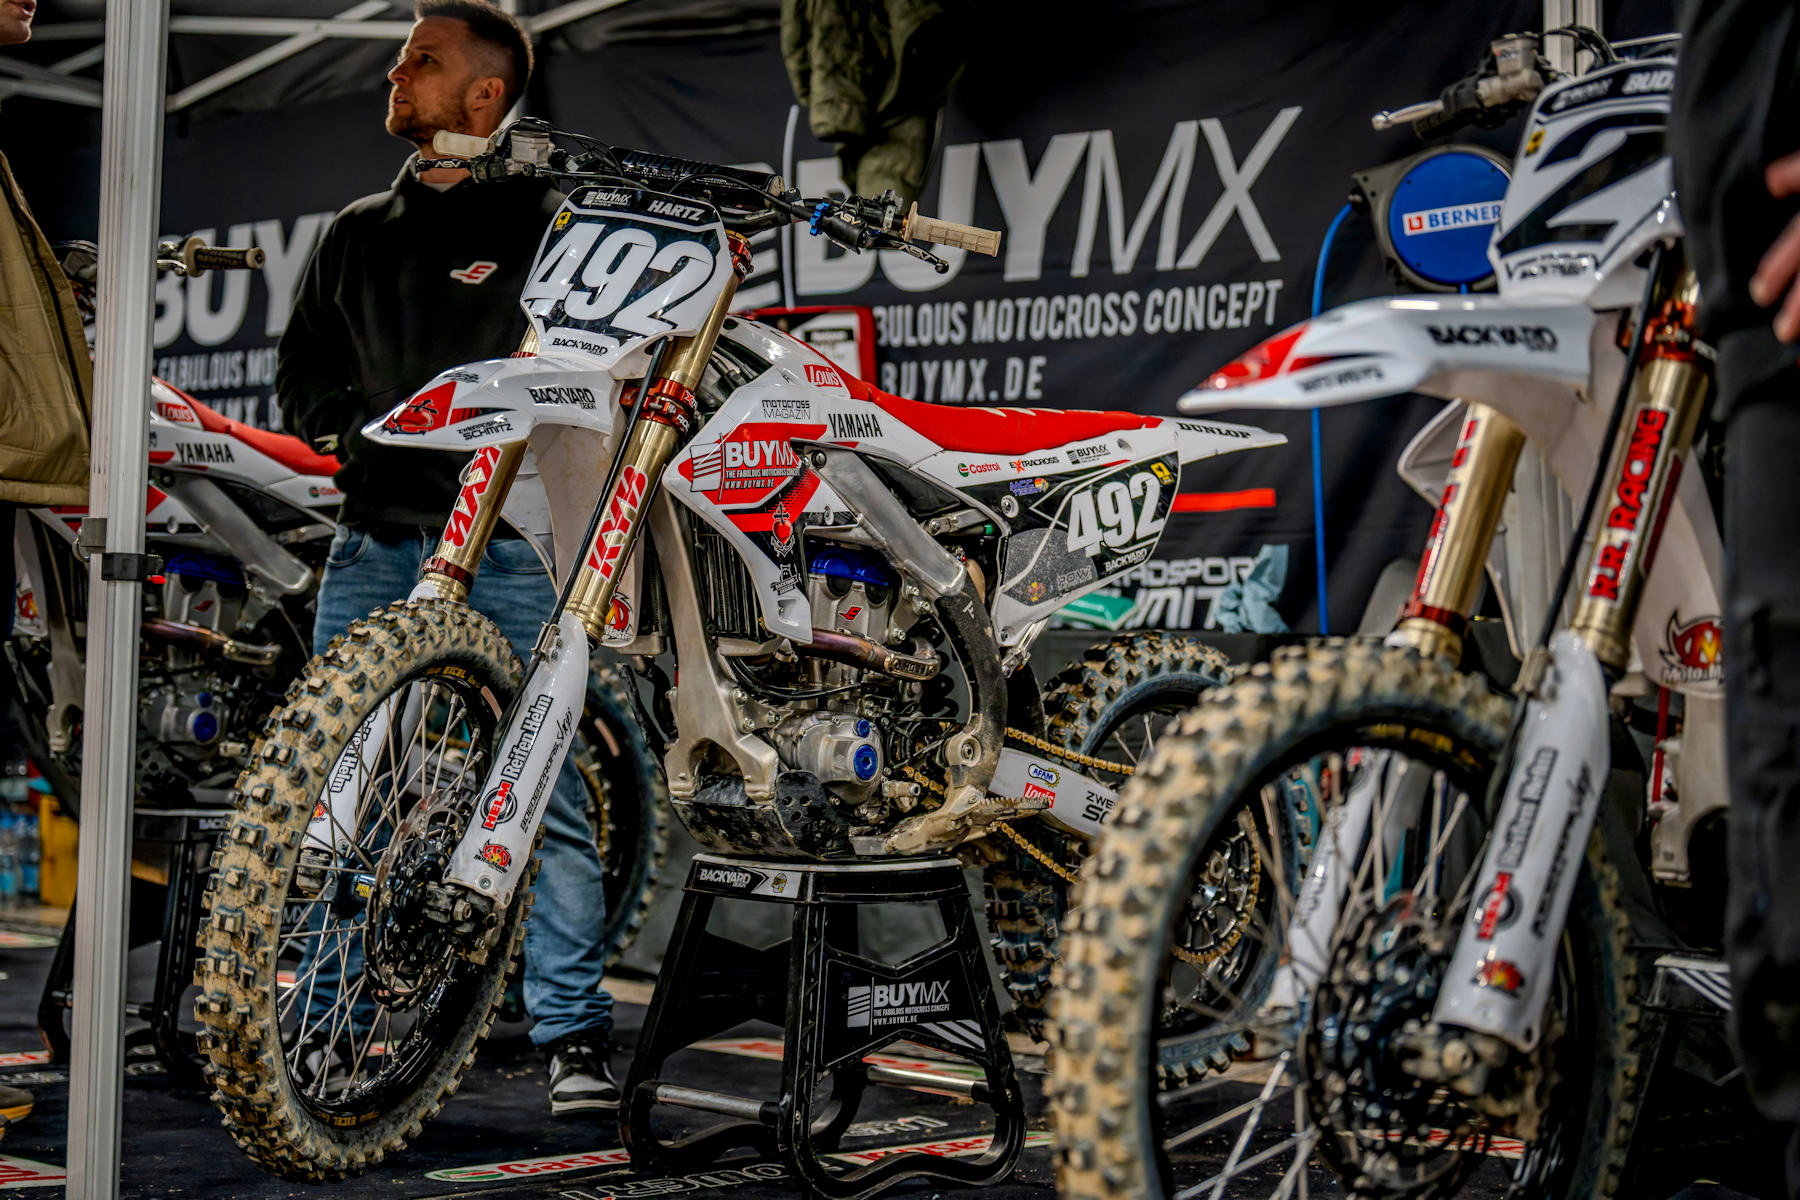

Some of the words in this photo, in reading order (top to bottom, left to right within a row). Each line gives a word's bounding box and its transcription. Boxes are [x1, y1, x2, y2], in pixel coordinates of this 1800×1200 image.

[647, 199, 706, 221] HARTZ
[833, 210, 862, 225] ASV
[1428, 204, 1502, 228] BERNER
[524, 221, 716, 337] 492
[873, 303, 967, 347] BULOUS
[971, 290, 1139, 344] MOTOCROSS
[1143, 280, 1283, 335] CONCEPT
[551, 337, 608, 355] BACKYARD
[809, 365, 840, 387] Louis
[525, 386, 596, 405] BACKYARD
[161, 403, 193, 421] Louis
[763, 408, 811, 420] MAGAZIN
[462, 423, 514, 441] SCHMITZ
[827, 413, 884, 439] YAMAHA
[1177, 421, 1252, 439] DUNLOP
[175, 442, 236, 463] YAMAHA
[969, 462, 1001, 475] Castrol
[1008, 456, 1060, 474] EXTRACROSS
[586, 465, 649, 583] KYB
[1066, 471, 1166, 558] 492
[1104, 548, 1148, 573] BACKYARD
[482, 780, 512, 830] HELM
[501, 727, 537, 781] Reifen
[520, 693, 553, 734] Helm
[1032, 767, 1054, 782] AFAM
[1086, 790, 1115, 810] ZWE
[700, 868, 752, 885] BACKYARD
[873, 979, 951, 1008] BUYMX
